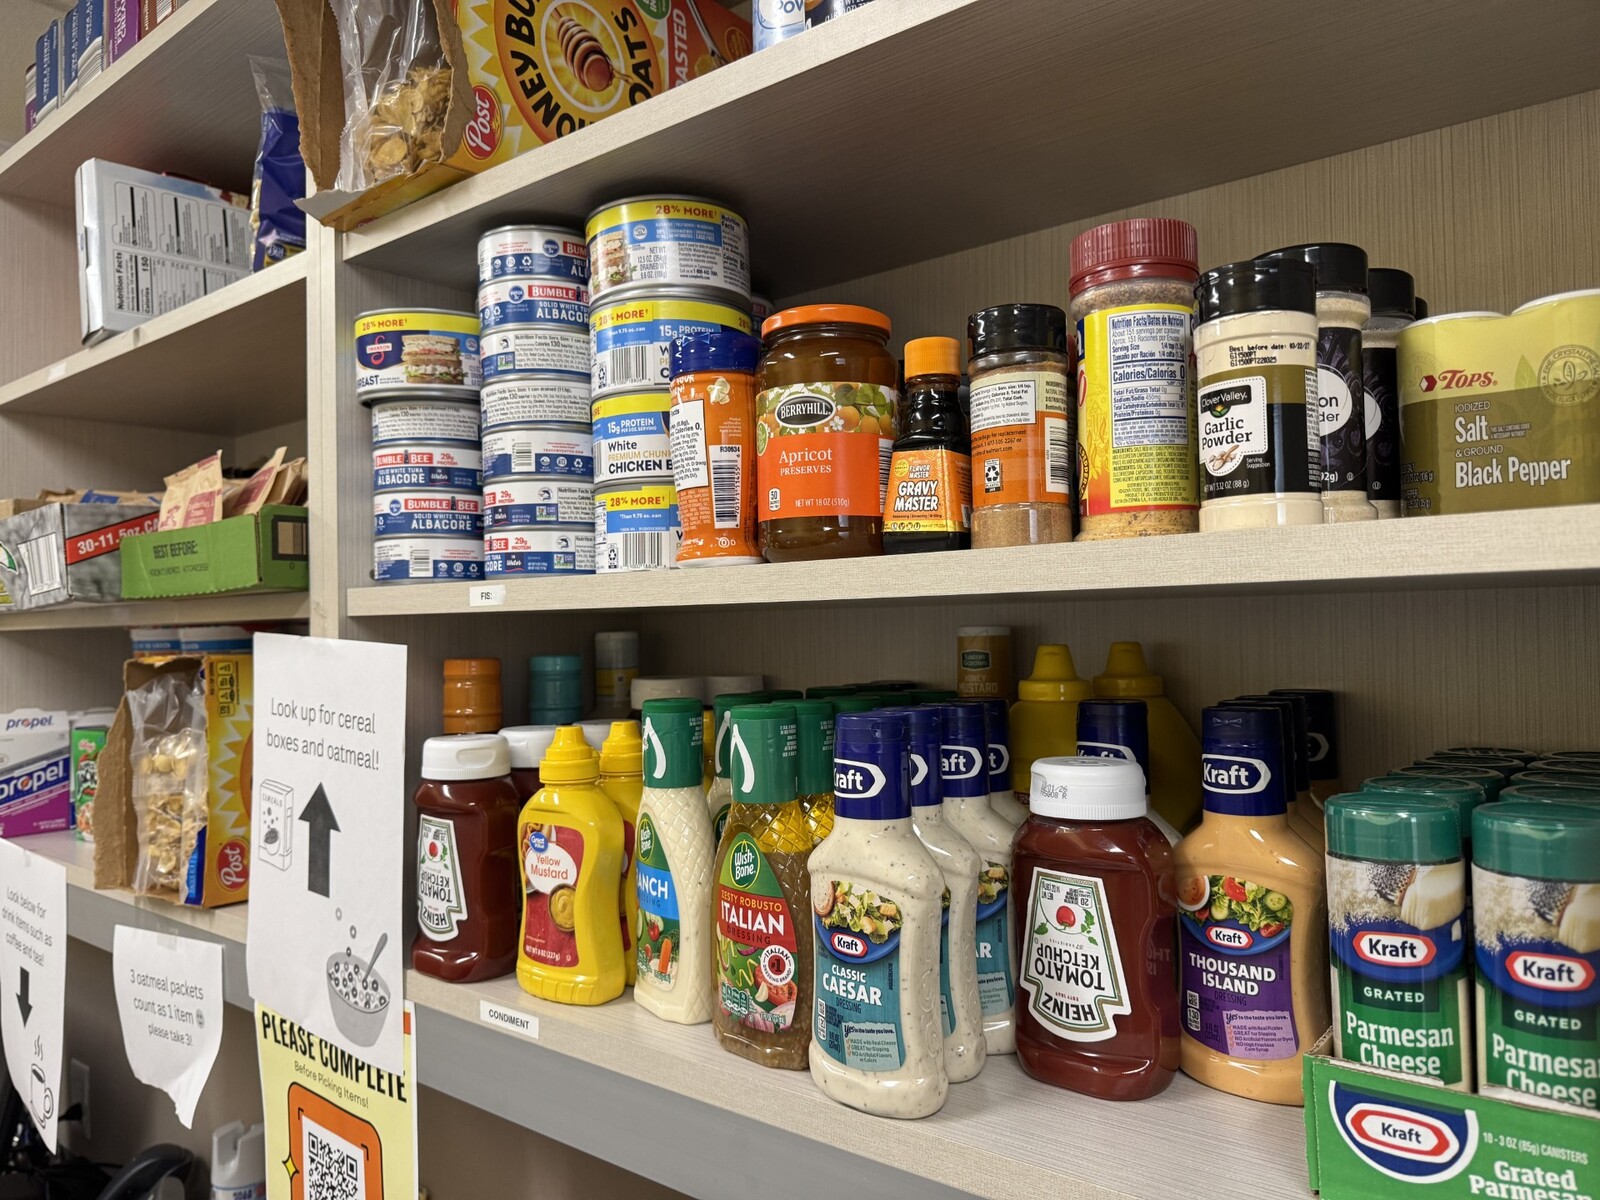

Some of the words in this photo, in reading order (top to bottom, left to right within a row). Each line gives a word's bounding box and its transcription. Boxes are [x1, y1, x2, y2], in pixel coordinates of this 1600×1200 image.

[465, 91, 491, 151] Post
[655, 205, 680, 215] 28%
[532, 286, 575, 299] BUMBLE
[1111, 317, 1132, 329] Nutrition
[1112, 329, 1125, 337] About
[1126, 328, 1135, 336] 151
[1112, 345, 1129, 354] Serving
[1113, 366, 1176, 382] Calories/Calorías
[1180, 364, 1185, 379] 0
[1220, 391, 1248, 401] Valley
[780, 401, 828, 418] BERRYHILL
[1454, 401, 1490, 413] IODIZED
[607, 421, 621, 435] 15g
[620, 418, 654, 427] PROTEIN
[1204, 417, 1244, 435] Garlic
[1454, 415, 1488, 443] Salt
[607, 440, 637, 452] White
[1202, 431, 1252, 450] Powder
[608, 451, 643, 462] PREMIUM
[779, 448, 833, 464] Apricot
[1455, 449, 1463, 457] &
[1463, 445, 1504, 457] GROUND
[376, 455, 403, 467] BUMBLE
[410, 454, 430, 463] BEE
[608, 460, 662, 475] CHICKEN
[909, 464, 930, 472] FLAVOR
[1246, 461, 1270, 469] Suggestion
[378, 473, 425, 486] ALBACORE
[780, 465, 832, 476] PRESERVES
[909, 471, 930, 479] MASTER
[1455, 458, 1503, 488] Black
[1507, 456, 1571, 486] Pepper
[771, 491, 778, 500] 50
[898, 480, 938, 496] GRAVY
[407, 500, 449, 509] BUMBLE
[458, 502, 476, 511] BEE
[610, 497, 628, 507] 28%
[894, 496, 939, 512] MASTER
[411, 520, 472, 531] ALBACORE
[153, 543, 169, 559] BEST
[170, 540, 199, 557] BEFORE:
[958, 682, 998, 693] MUSTARD
[6, 715, 52, 731] propel
[271, 697, 298, 719] Look
[301, 707, 316, 725] up
[319, 704, 336, 726] for
[338, 712, 376, 735] cereal
[267, 728, 299, 752] boxes
[302, 738, 325, 757] and
[328, 748, 380, 771] oatmeal!
[1203, 762, 1249, 786] Kraft
[530, 835, 546, 843] Great
[220, 846, 241, 888] Post
[536, 854, 561, 867] Yellow
[734, 850, 755, 869] Wish-
[421, 870, 450, 888] KETCHUP
[530, 864, 569, 880] Mustard
[421, 882, 452, 903] TOMATO
[721, 889, 739, 904] ZESTY
[739, 894, 783, 912] ROBUSTO
[7, 887, 22, 903] Look
[21, 892, 37, 913] below
[37, 904, 46, 919] for
[423, 907, 447, 926] HEINZ
[720, 900, 785, 936] ITALIAN
[2, 907, 16, 923] drink
[16, 914, 30, 929] items
[30, 921, 43, 938] such
[44, 936, 53, 947] as
[726, 926, 771, 945] DRESSING
[836, 936, 859, 952] Kraft
[1215, 929, 1242, 945] Kraft
[6, 933, 22, 950] coffee
[22, 942, 33, 959] and
[33, 950, 45, 966] tea!
[764, 948, 789, 961] ITALIAN
[1037, 943, 1100, 970] KETCHUP
[1368, 938, 1417, 958] Kraft
[831, 964, 867, 983] CLASSIC
[1034, 959, 1106, 991] TOMATO
[1189, 952, 1276, 982] THOUSAND
[1522, 959, 1575, 983] Kraft
[130, 969, 136, 983] 3
[137, 972, 169, 993] oatmeal
[171, 980, 204, 1000] packets
[822, 972, 883, 1006] CAESAR
[1202, 971, 1260, 996] ISLAND
[1214, 991, 1247, 1006] DRESSING
[1363, 986, 1425, 1003] GRATED
[133, 996, 155, 1014] count
[155, 1003, 166, 1015] as
[167, 1005, 173, 1019] 1
[173, 1008, 194, 1025] item
[835, 996, 862, 1014] DRESSING
[1042, 992, 1096, 1021] HEINZ
[488, 1008, 530, 1030] CONDIMENT
[1226, 1013, 1238, 1024] Yes
[1514, 1009, 1582, 1031] GRATED
[148, 1023, 169, 1040] please
[169, 1027, 185, 1044] take
[185, 1033, 193, 1047] 3!
[1346, 1011, 1454, 1046] Parmesan
[262, 1010, 316, 1061] PLEASE
[319, 1036, 407, 1103] COMPLETE
[1360, 1043, 1441, 1075] Cheese
[1492, 1033, 1600, 1079] Parmesa
[294, 1060, 317, 1081] Before
[318, 1072, 344, 1098] Picking
[344, 1083, 369, 1108] Items!
[1506, 1068, 1596, 1107] Cheese
[1380, 1122, 1422, 1144] Kraft
[1483, 1132, 1493, 1143] 10
[1499, 1135, 1505, 1146] 3
[1506, 1136, 1518, 1149] OZ
[1518, 1139, 1540, 1156] (85g)
[1540, 1145, 1589, 1165] CANISTERS
[1494, 1160, 1578, 1191] Grated
